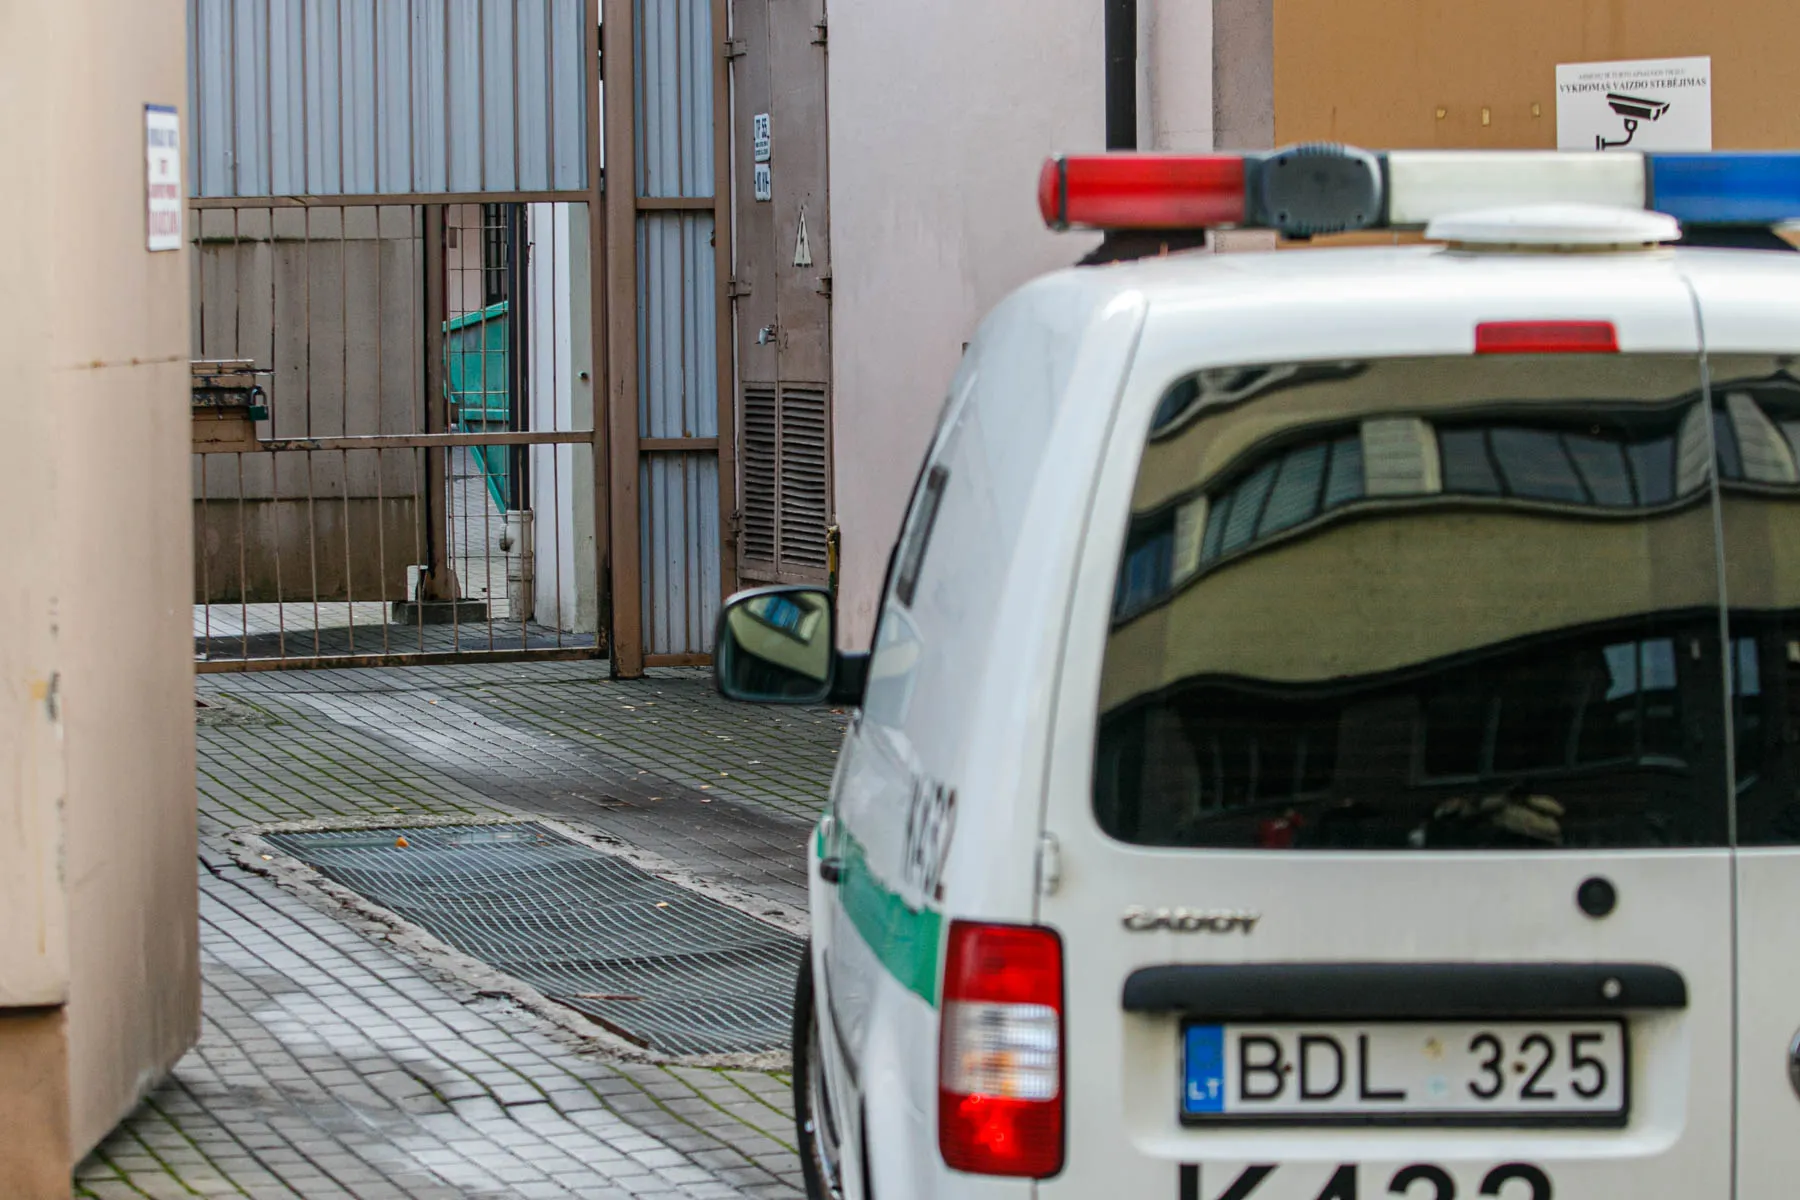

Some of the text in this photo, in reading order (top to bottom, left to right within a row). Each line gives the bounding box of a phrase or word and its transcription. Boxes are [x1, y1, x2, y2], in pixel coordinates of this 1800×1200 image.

[1560, 76, 1707, 94] VYKDOMAS VAIZDO STEBĖJIMAS
[1122, 904, 1262, 935] CADDY
[1239, 1032, 1607, 1101] BDL 325
[1188, 1077, 1222, 1100] LT
